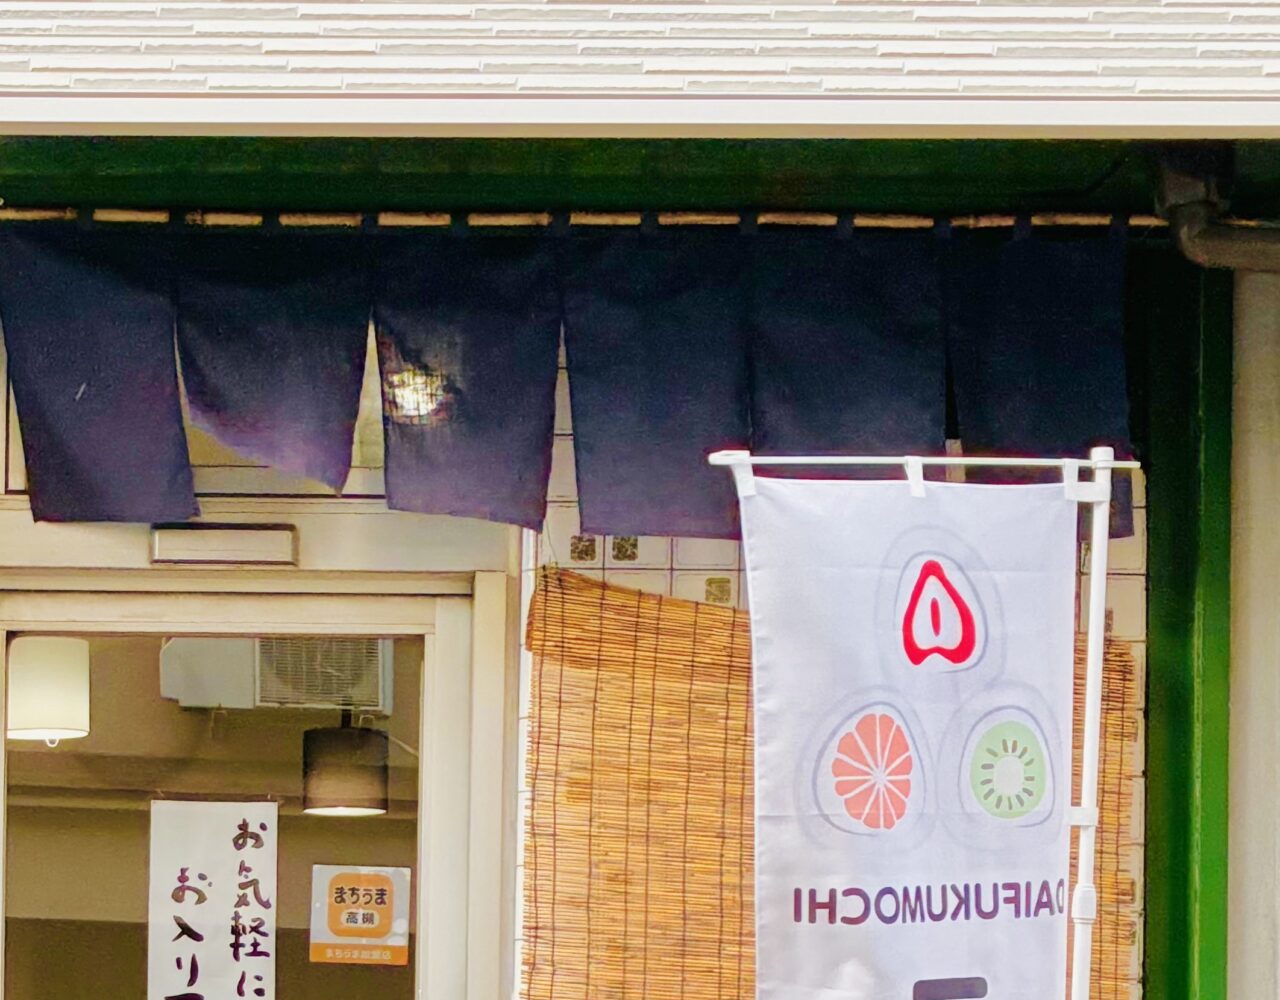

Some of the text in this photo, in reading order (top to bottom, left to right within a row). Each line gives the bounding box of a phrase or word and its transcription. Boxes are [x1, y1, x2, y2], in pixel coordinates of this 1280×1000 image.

[230, 817, 272, 998] お気軽に
[333, 885, 388, 906] まちうま
